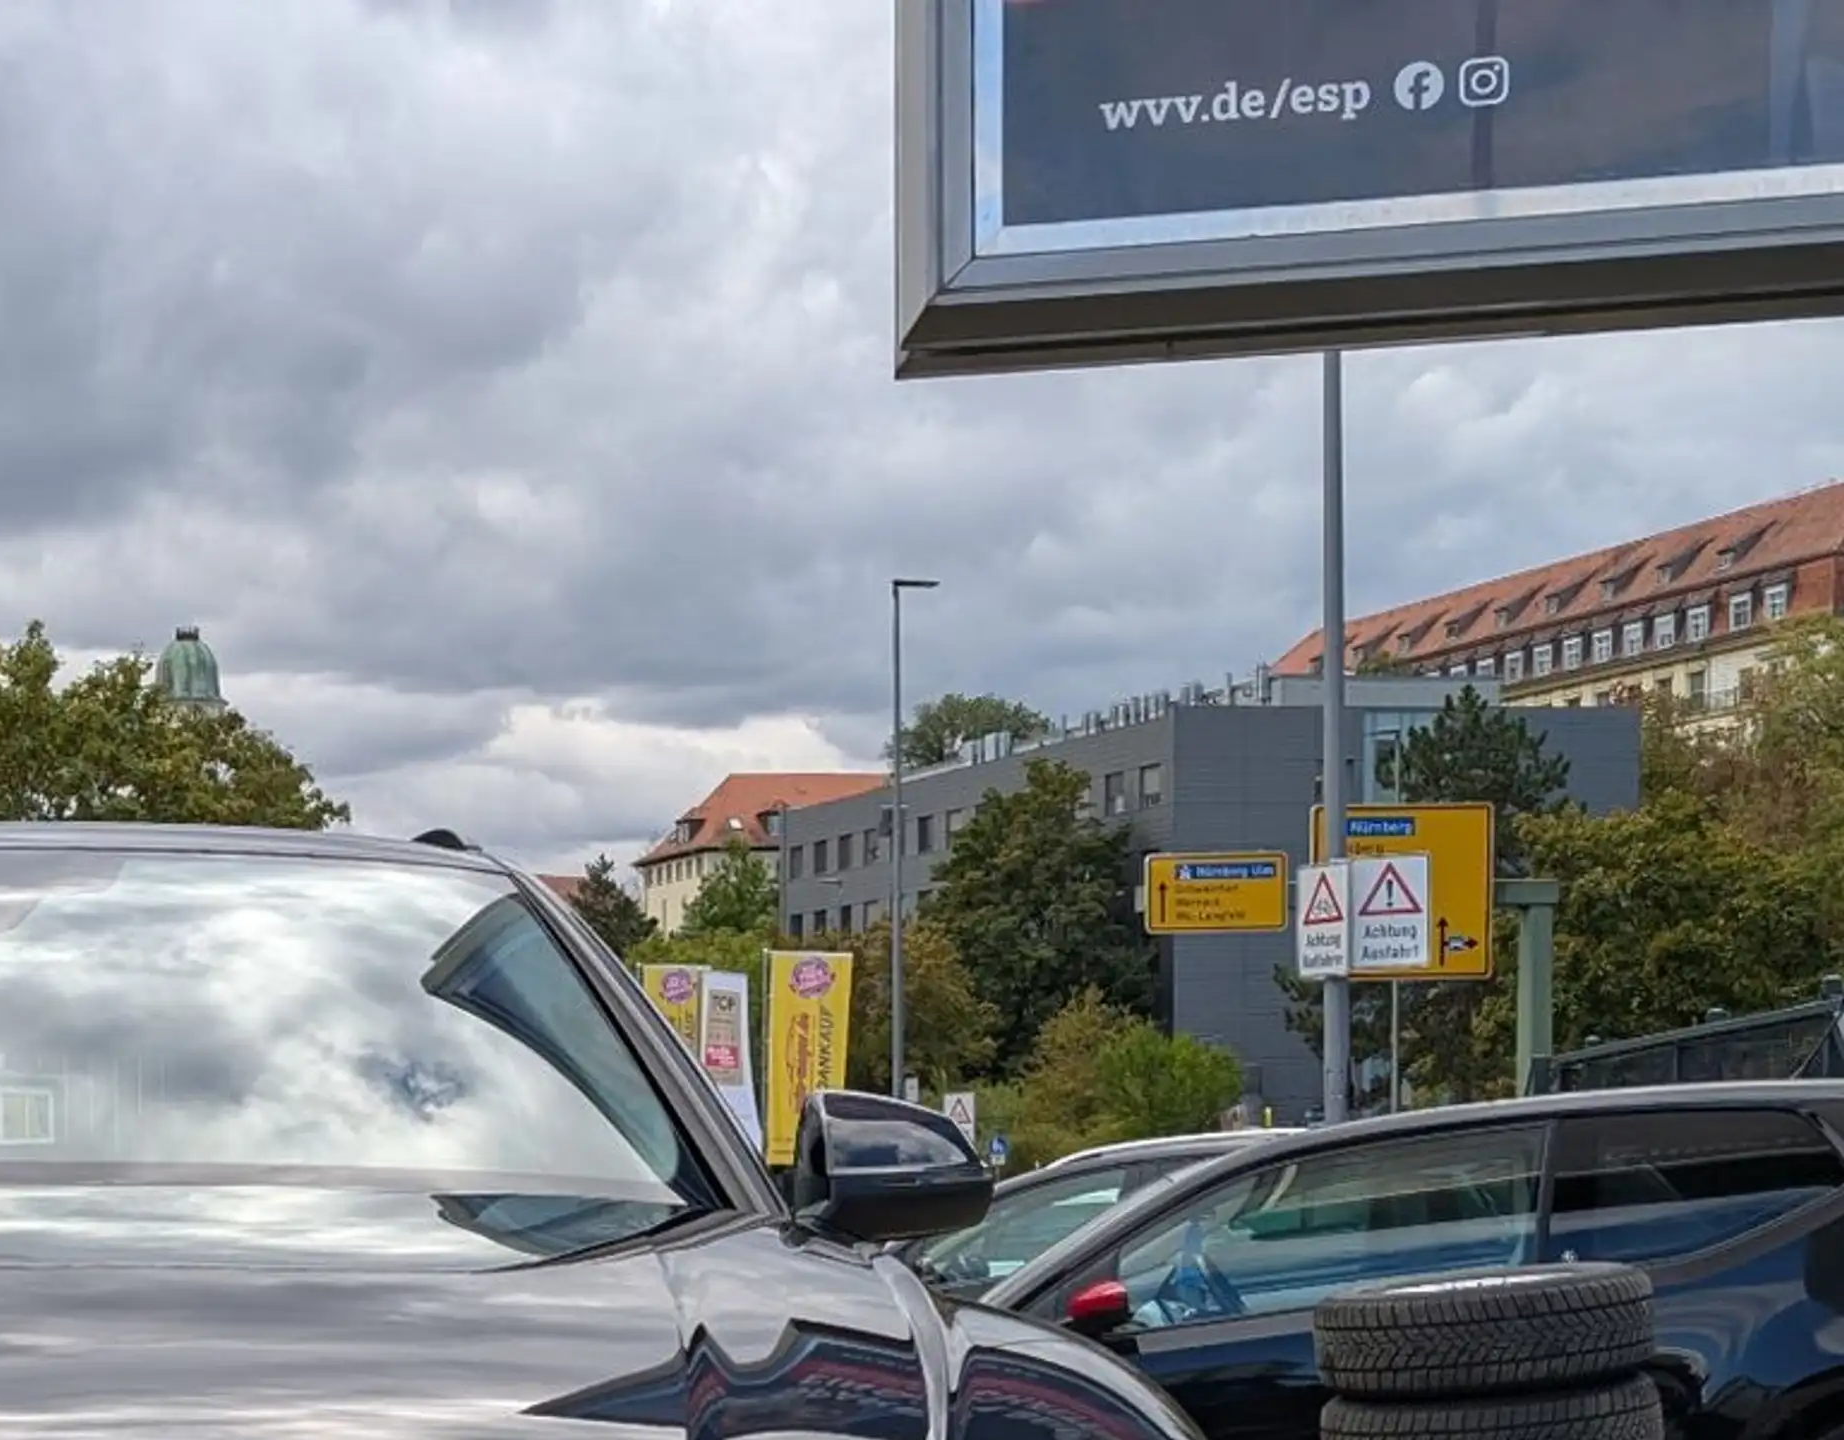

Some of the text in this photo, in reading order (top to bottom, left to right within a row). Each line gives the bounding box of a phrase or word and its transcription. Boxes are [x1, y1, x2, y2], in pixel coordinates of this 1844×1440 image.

[1098, 78, 1371, 131] wvv.de/esp
[1361, 923, 1418, 940] Achtung
[1360, 945, 1420, 961] Ausfahrt
